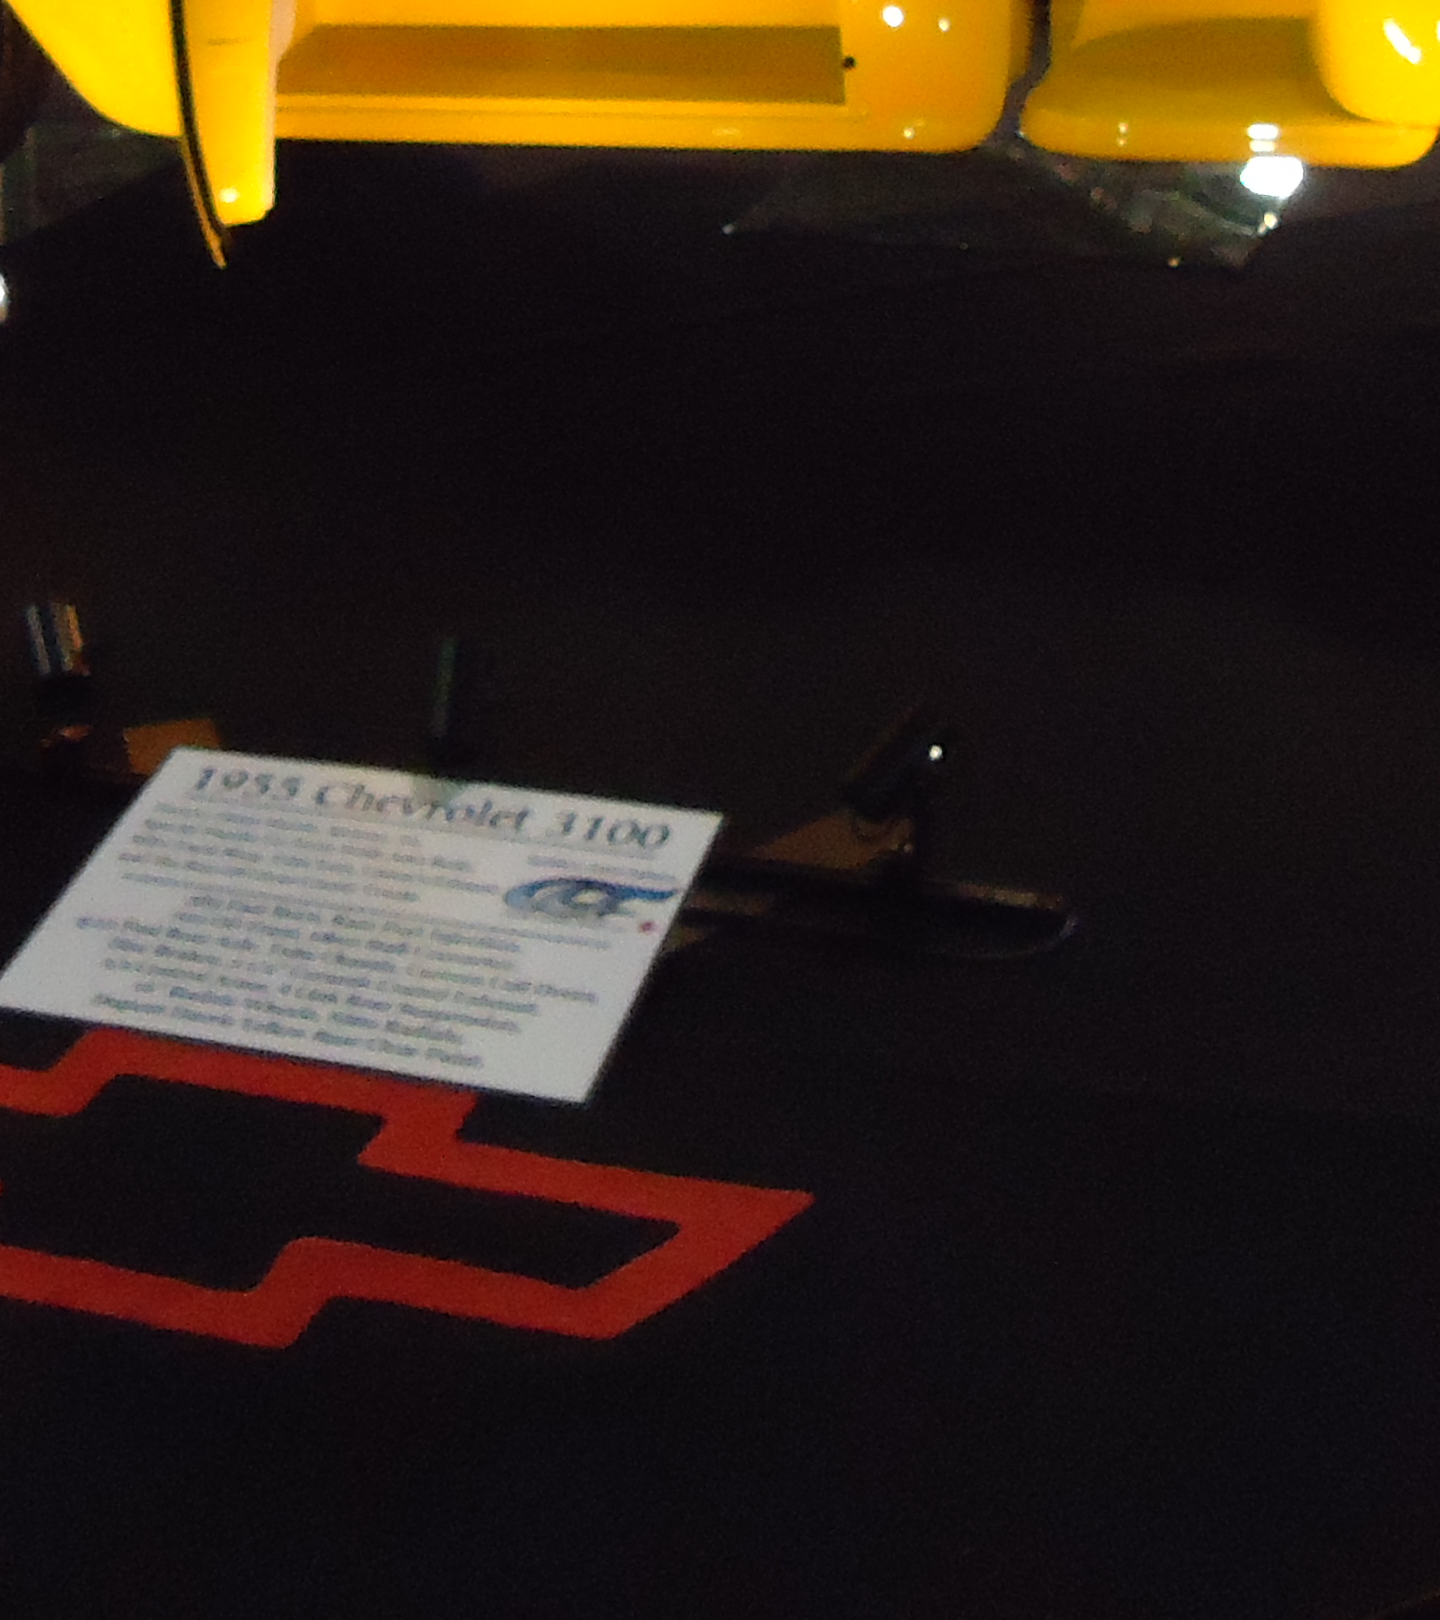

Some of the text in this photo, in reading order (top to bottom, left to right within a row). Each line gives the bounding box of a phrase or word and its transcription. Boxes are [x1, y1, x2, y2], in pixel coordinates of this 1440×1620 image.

[192, 765, 673, 850] 1955 Chevrolet 3100
